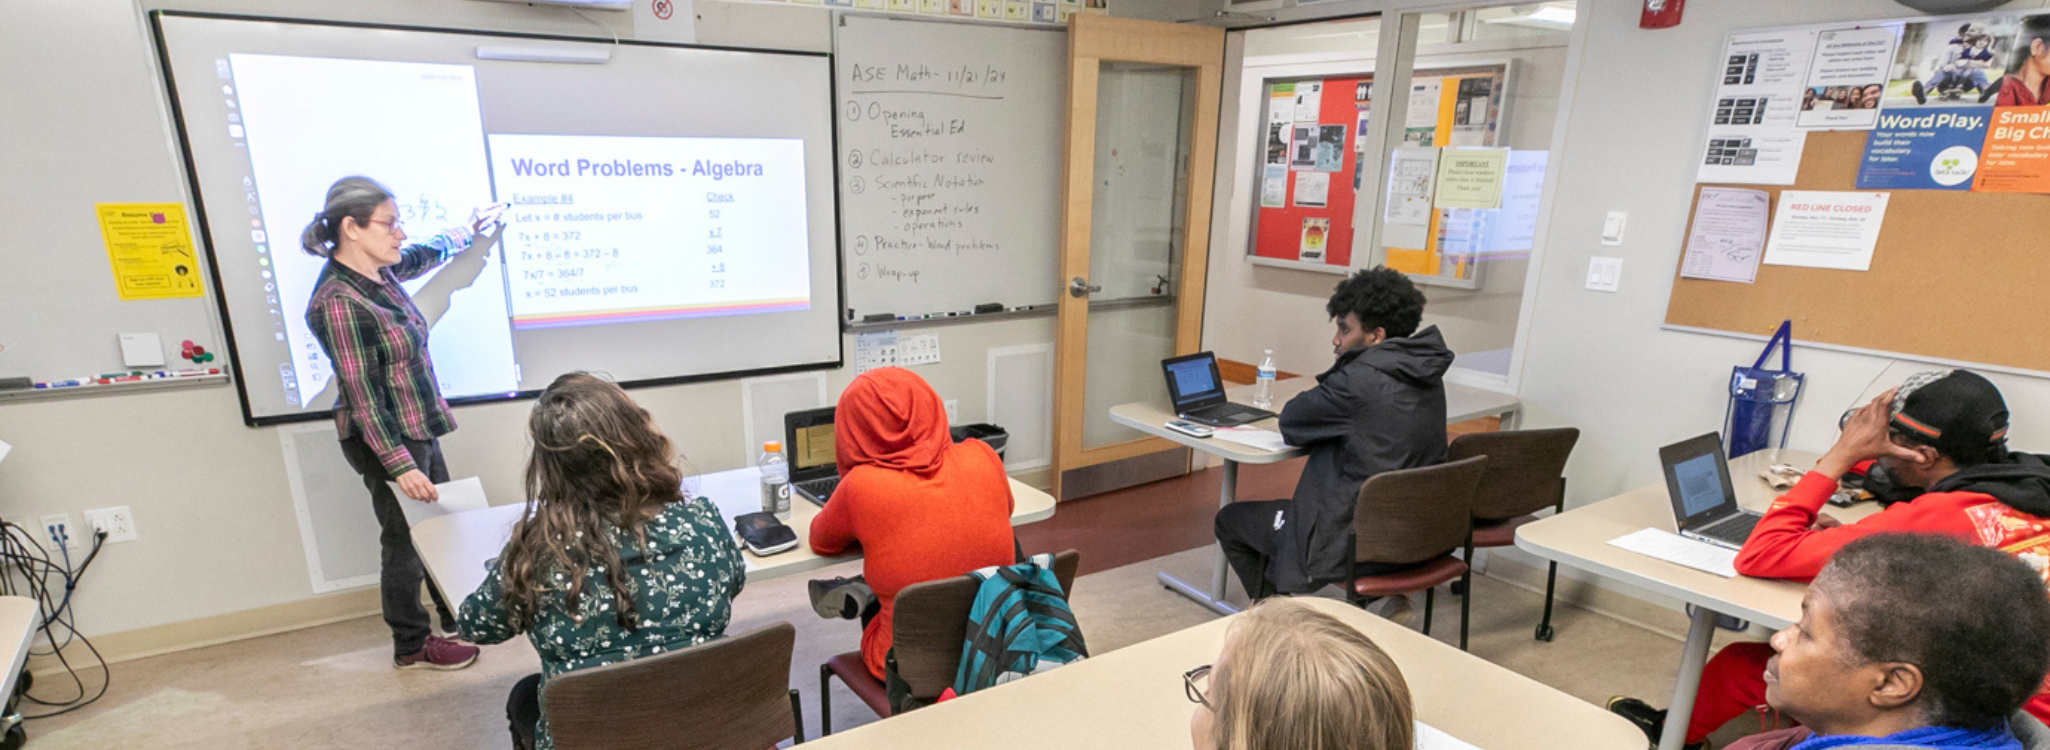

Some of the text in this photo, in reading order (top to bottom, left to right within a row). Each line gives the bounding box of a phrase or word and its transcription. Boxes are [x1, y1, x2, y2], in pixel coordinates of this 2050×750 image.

[852, 63, 887, 83] ASE
[868, 101, 925, 127] Opening
[890, 119, 965, 138] Essential Ed
[1880, 113, 1984, 131] Word Play.
[1993, 126, 2025, 142] Big
[870, 148, 945, 166] Calculator
[957, 150, 995, 165] review
[1870, 148, 1912, 156] vocabulary
[2007, 152, 2049, 160] vocabulary
[511, 158, 571, 177] Word
[576, 158, 674, 177] Problems
[692, 159, 764, 181] Algebra
[933, 174, 985, 188] Notation
[513, 193, 574, 205] Example #4
[706, 191, 734, 203] Check
[709, 209, 720, 219] 52
[902, 203, 948, 221] exponent
[953, 203, 980, 214] rules
[1790, 203, 1872, 214] RED LINE CLOSED
[515, 213, 532, 223] Let
[553, 213, 560, 221] #
[563, 212, 605, 222] students
[607, 213, 622, 224] per
[625, 211, 643, 221] bus
[903, 217, 963, 236] operations
[519, 232, 531, 241] 7x
[543, 231, 550, 241] 8
[562, 231, 581, 241] 372
[706, 244, 723, 254] 364
[926, 236, 952, 251] Word
[956, 237, 999, 256] problems
[521, 251, 533, 261] 7x
[545, 250, 553, 260] 8
[563, 249, 571, 260] 8
[583, 248, 601, 259] 372
[612, 248, 619, 258] 8
[523, 270, 545, 280] 7x/7
[557, 268, 585, 279] 364/7
[719, 262, 726, 273] 8
[876, 263, 920, 283] Wrap-up
[544, 287, 557, 298] 52
[559, 287, 601, 297] students
[603, 287, 619, 297] per
[621, 284, 639, 294] bus
[709, 279, 726, 289] 372
[778, 483, 788, 499] G
